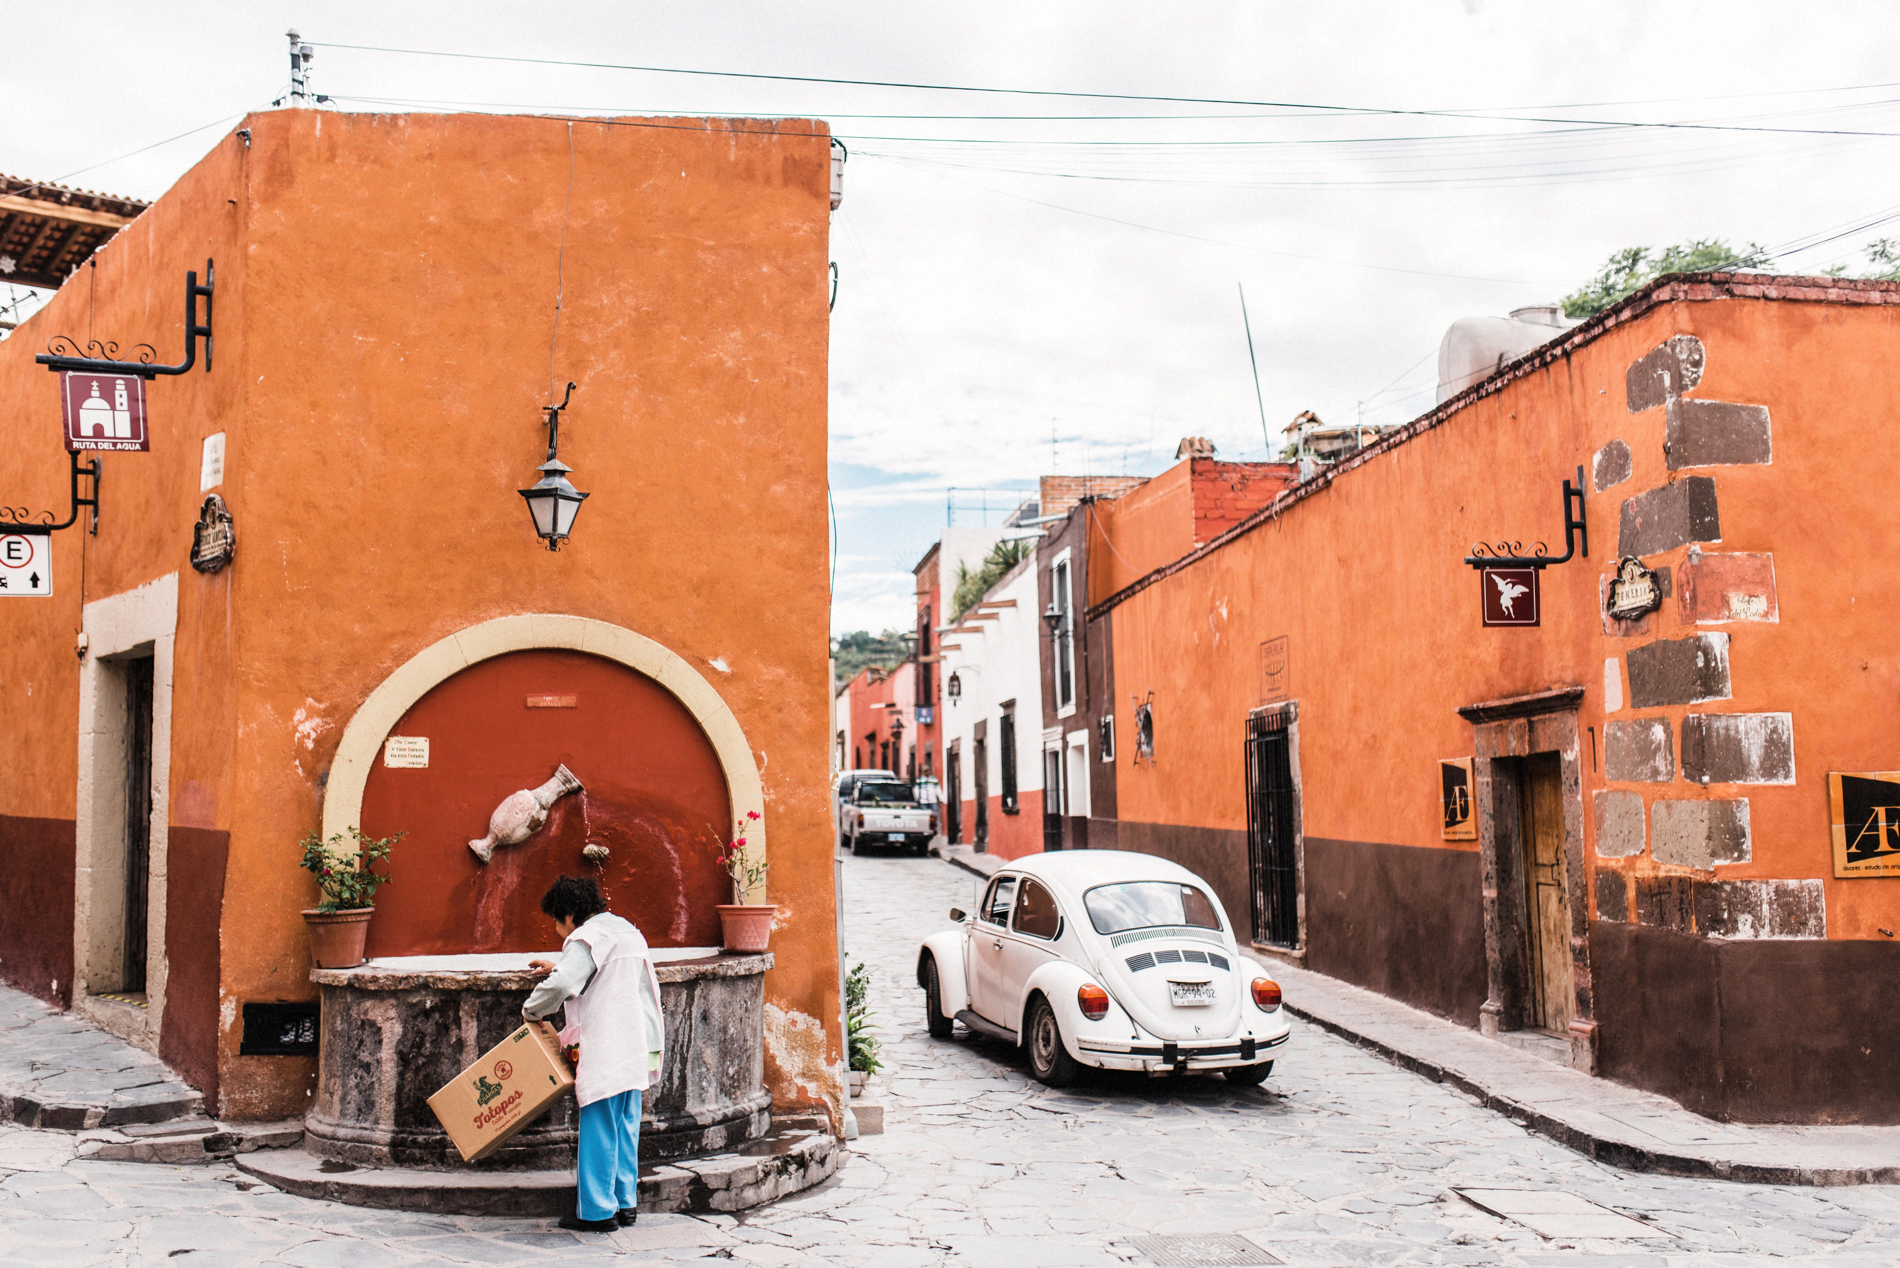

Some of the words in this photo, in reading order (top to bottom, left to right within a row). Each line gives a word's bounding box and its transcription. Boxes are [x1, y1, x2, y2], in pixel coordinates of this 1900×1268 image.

[98, 442, 115, 450] DEL
[7, 541, 22, 560] E
[876, 820, 918, 828] TOYOTA
[473, 1090, 523, 1129] Totopos
